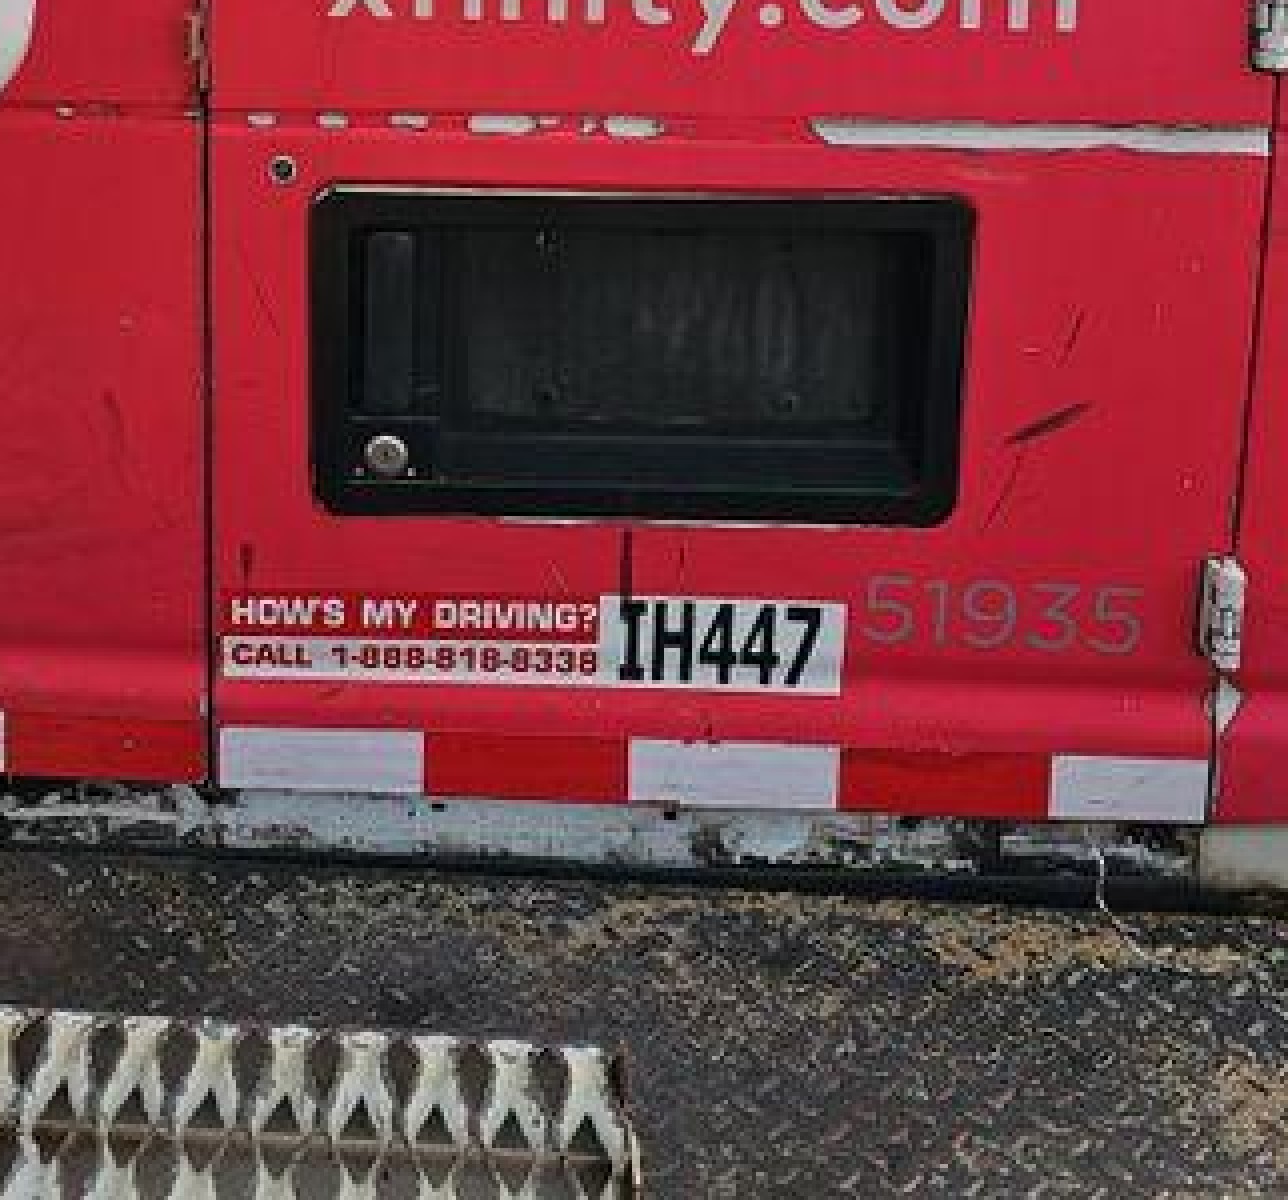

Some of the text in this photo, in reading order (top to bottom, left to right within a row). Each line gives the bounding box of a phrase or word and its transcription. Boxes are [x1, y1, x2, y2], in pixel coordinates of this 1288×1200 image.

[230, 596, 600, 633] HOW'S MY DRIVING?
[616, 599, 823, 688] IH447
[861, 572, 1143, 656] 51935
[230, 642, 313, 668] CALL
